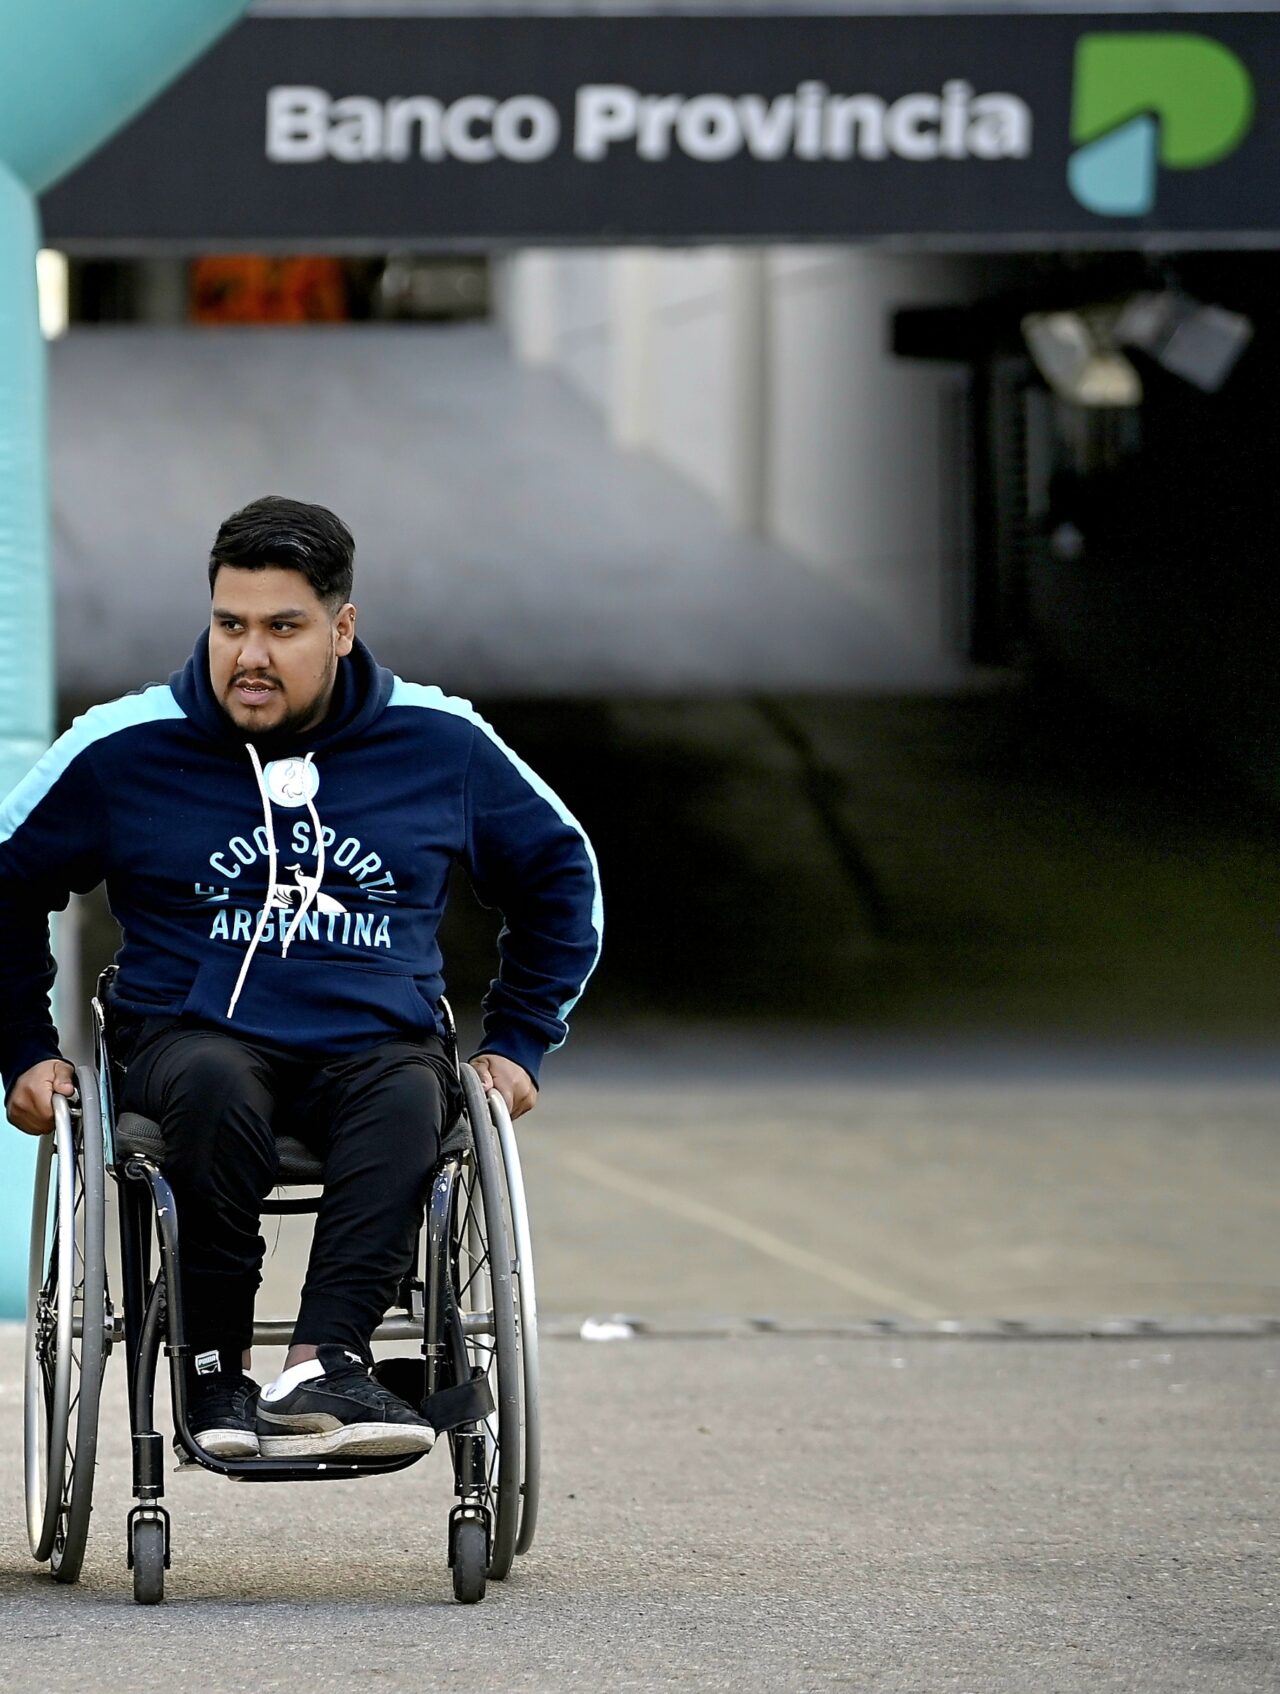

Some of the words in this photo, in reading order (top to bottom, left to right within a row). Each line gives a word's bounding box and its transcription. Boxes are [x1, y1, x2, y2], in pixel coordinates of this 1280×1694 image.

[265, 86, 558, 163] Banco
[574, 79, 1032, 161] Provincia
[209, 908, 392, 949] ARGENTINA
